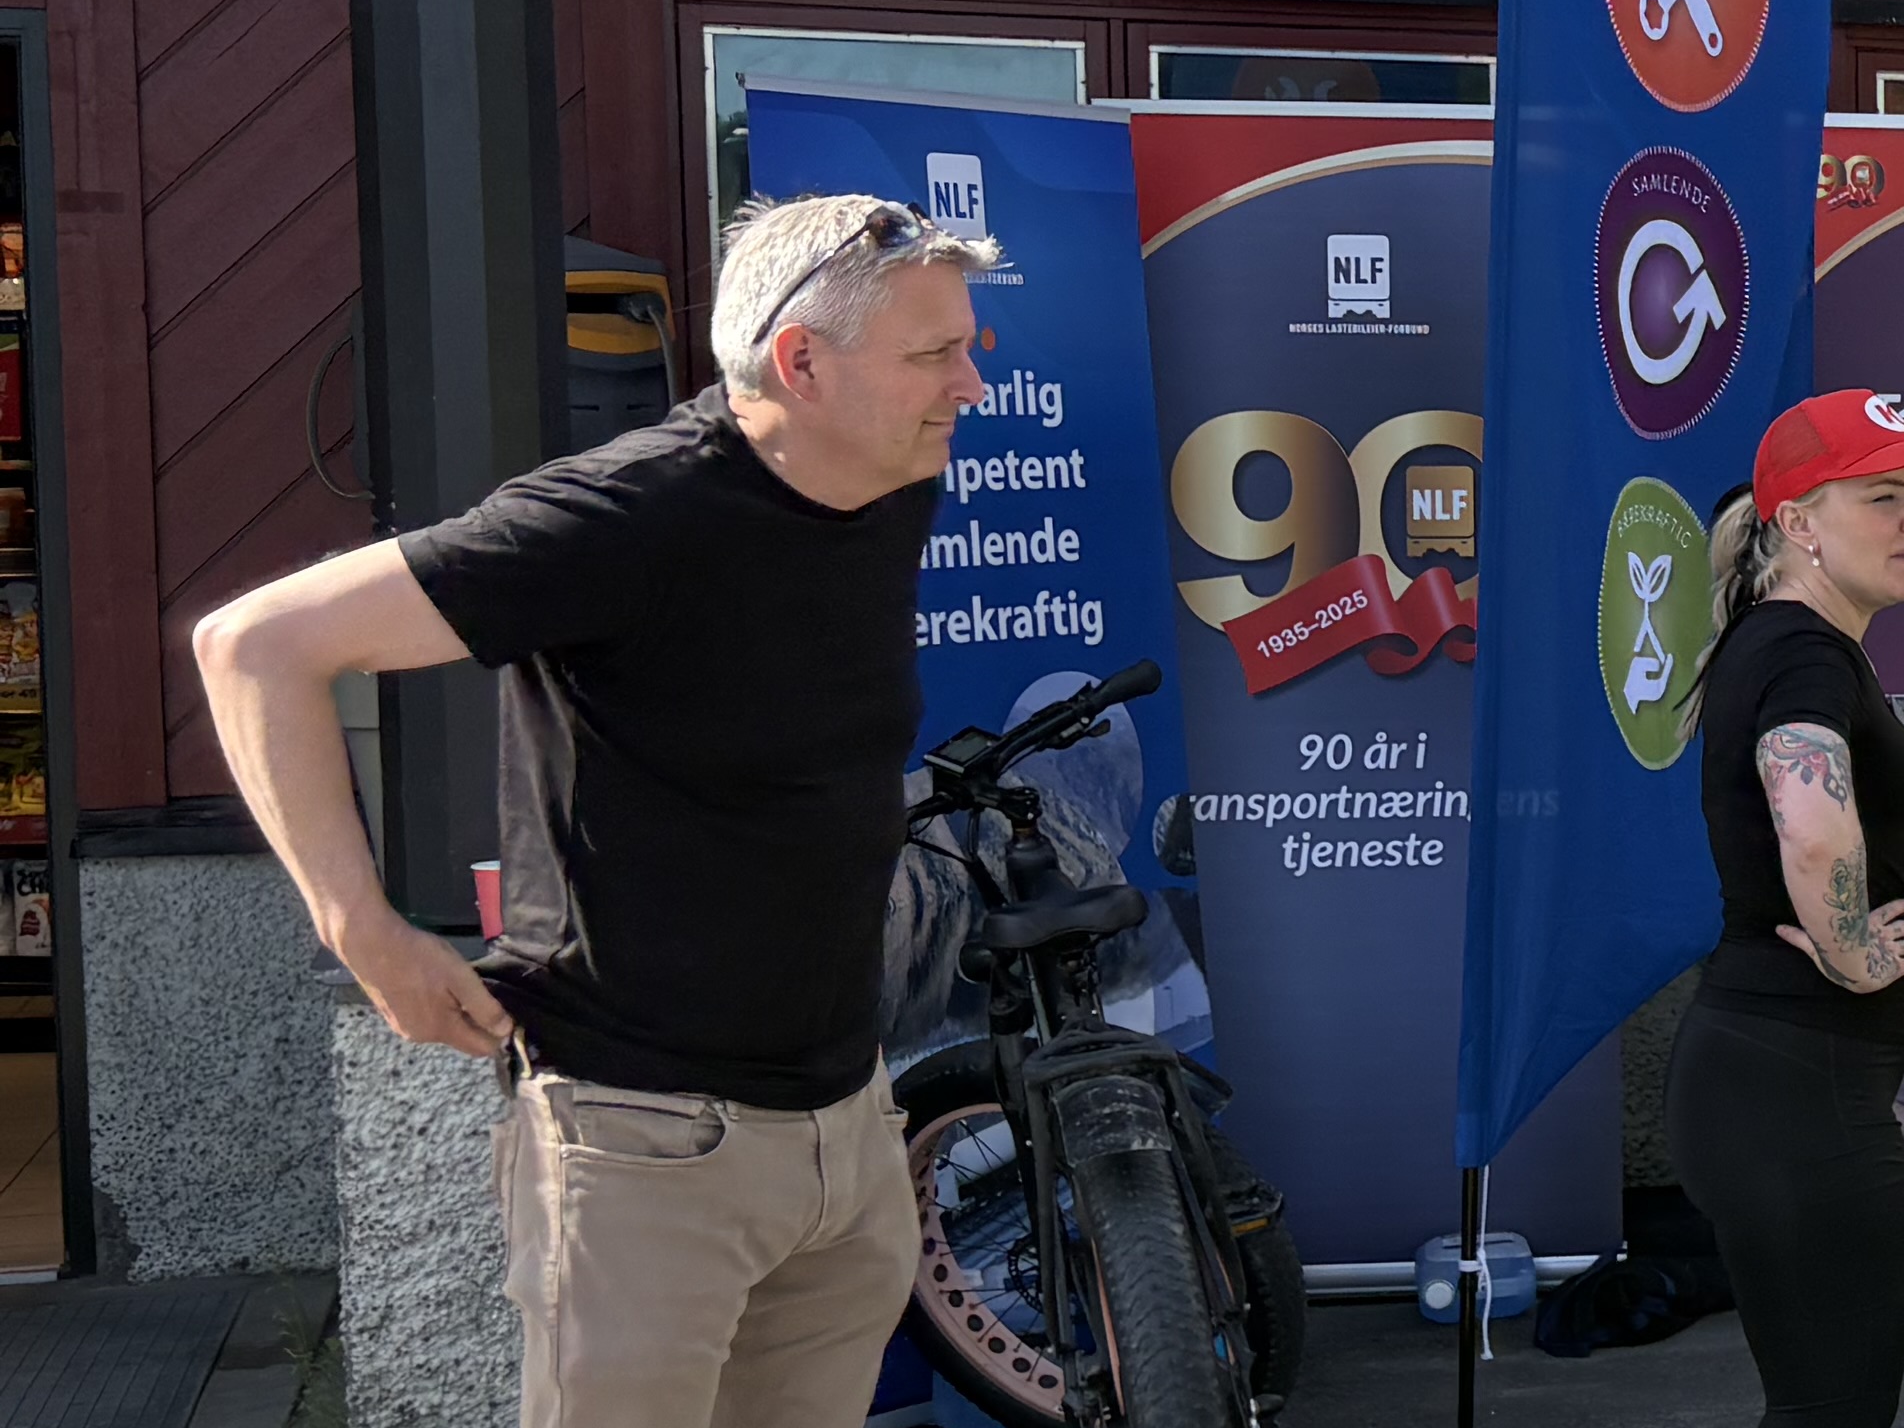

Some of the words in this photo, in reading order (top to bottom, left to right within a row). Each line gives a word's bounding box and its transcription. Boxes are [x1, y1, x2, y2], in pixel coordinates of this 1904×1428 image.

[934, 181, 979, 219] NLF
[1632, 173, 1711, 213] SAMLENDE
[1333, 256, 1384, 285] NLF
[959, 369, 1064, 428] arlig
[945, 448, 1086, 505] petent
[1412, 488, 1468, 521] NLF
[920, 516, 1080, 570] mlende
[1299, 733, 1353, 771] 90
[1362, 731, 1408, 770] år
[1415, 732, 1428, 769] i
[1189, 780, 1472, 828] ansportnærin
[1282, 831, 1444, 877] tjeneste
